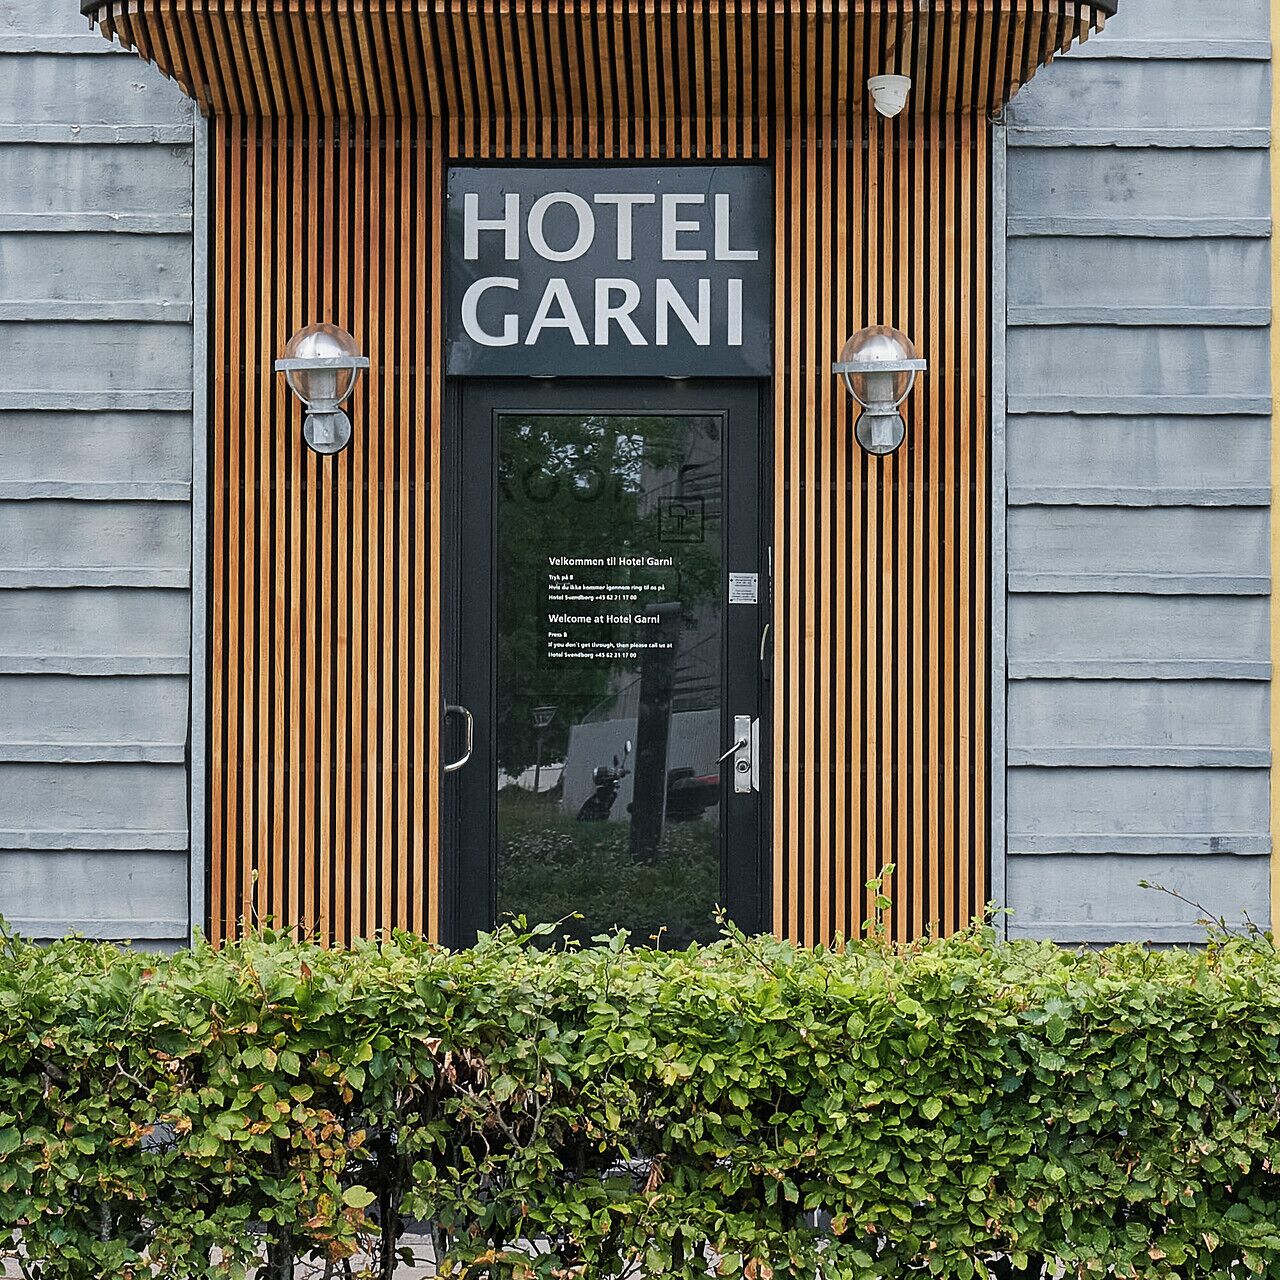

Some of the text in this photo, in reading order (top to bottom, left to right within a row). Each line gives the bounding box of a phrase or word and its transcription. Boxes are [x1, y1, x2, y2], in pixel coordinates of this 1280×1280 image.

[464, 192, 759, 262] HOTEL
[461, 276, 743, 347] GARNI
[548, 556, 673, 566] Velkommen til Hotel Garni
[548, 614, 660, 624] Welcome at Hotel Garni
